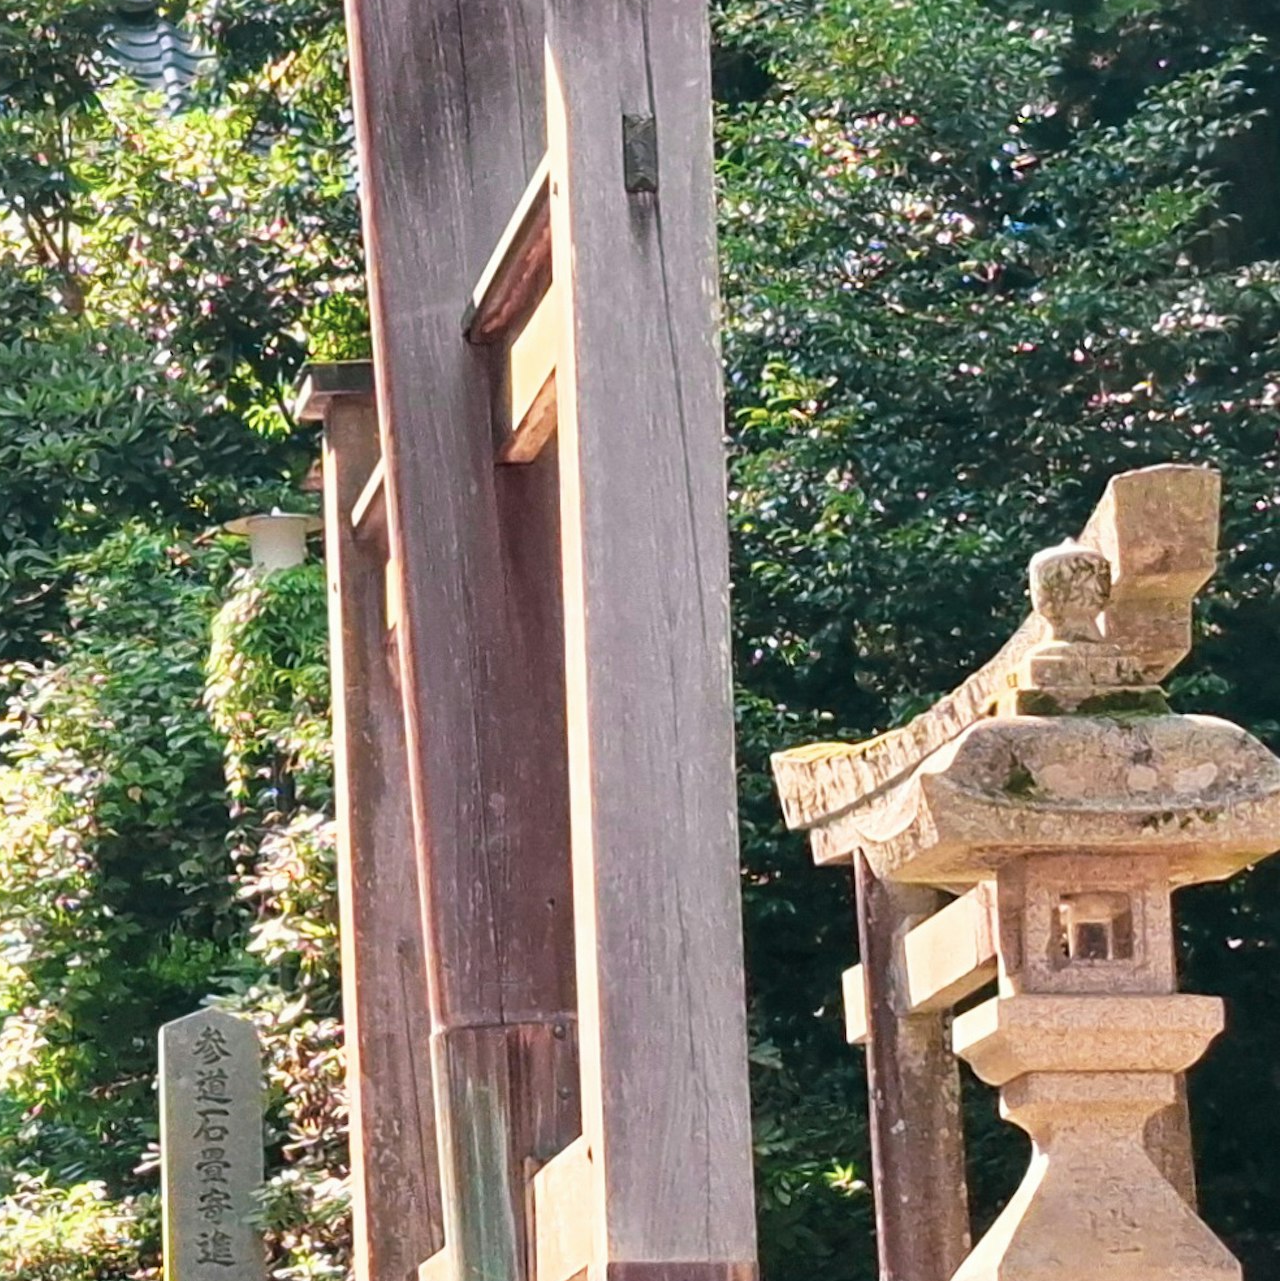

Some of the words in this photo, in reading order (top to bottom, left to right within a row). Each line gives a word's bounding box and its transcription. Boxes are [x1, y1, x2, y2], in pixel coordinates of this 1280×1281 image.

[192, 1026, 236, 1268] 参道石畳寄進
